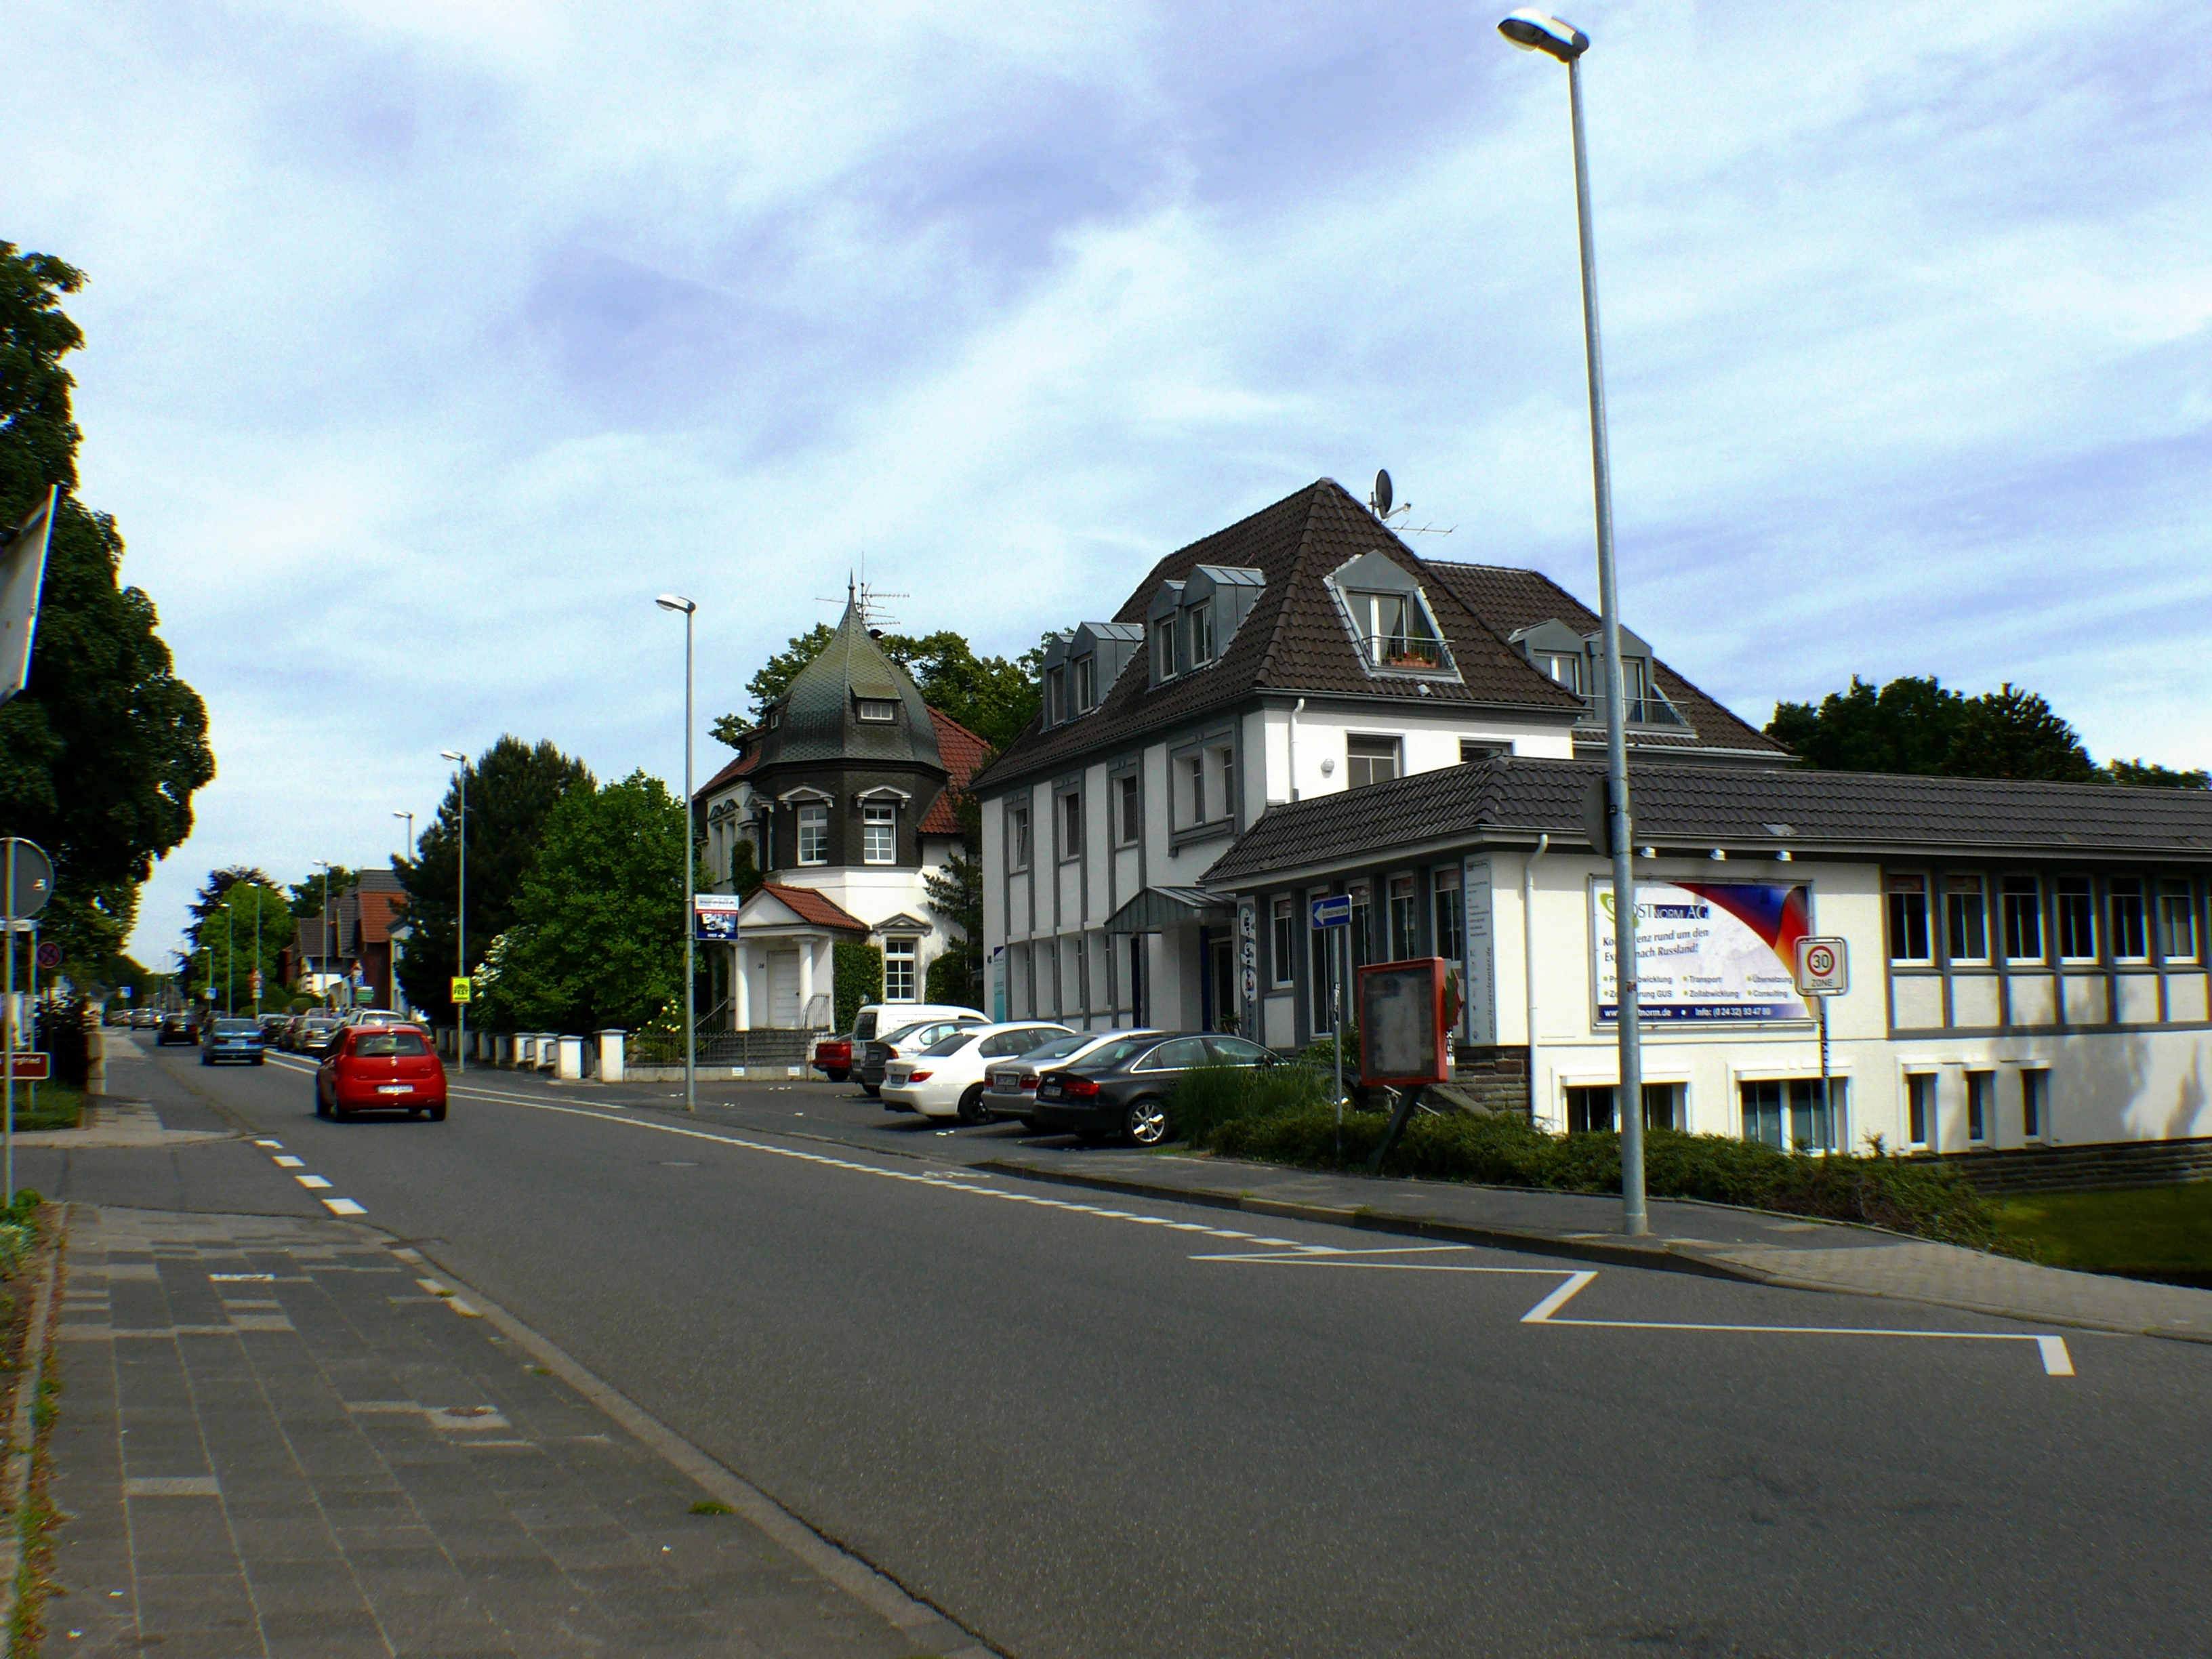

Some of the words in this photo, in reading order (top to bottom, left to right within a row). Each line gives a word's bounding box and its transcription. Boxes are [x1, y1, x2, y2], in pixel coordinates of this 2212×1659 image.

[1687, 905, 1708, 919] AG
[1603, 935, 1652, 947] Koenz
[1654, 930, 1675, 941] rund
[1677, 931, 1690, 939] um
[1692, 928, 1708, 938] den
[1634, 947, 1655, 958] nach
[1658, 943, 1698, 956] Russland!
[1813, 954, 1829, 968] 30
[1689, 975, 1721, 983] Transport
[1753, 974, 1793, 984] Übersetzung
[1811, 979, 1832, 987] ZONE
[1689, 990, 1739, 998] Zollabwicklung
[1753, 990, 1788, 998] Consulting
[1695, 1008, 1711, 1016] Info:
